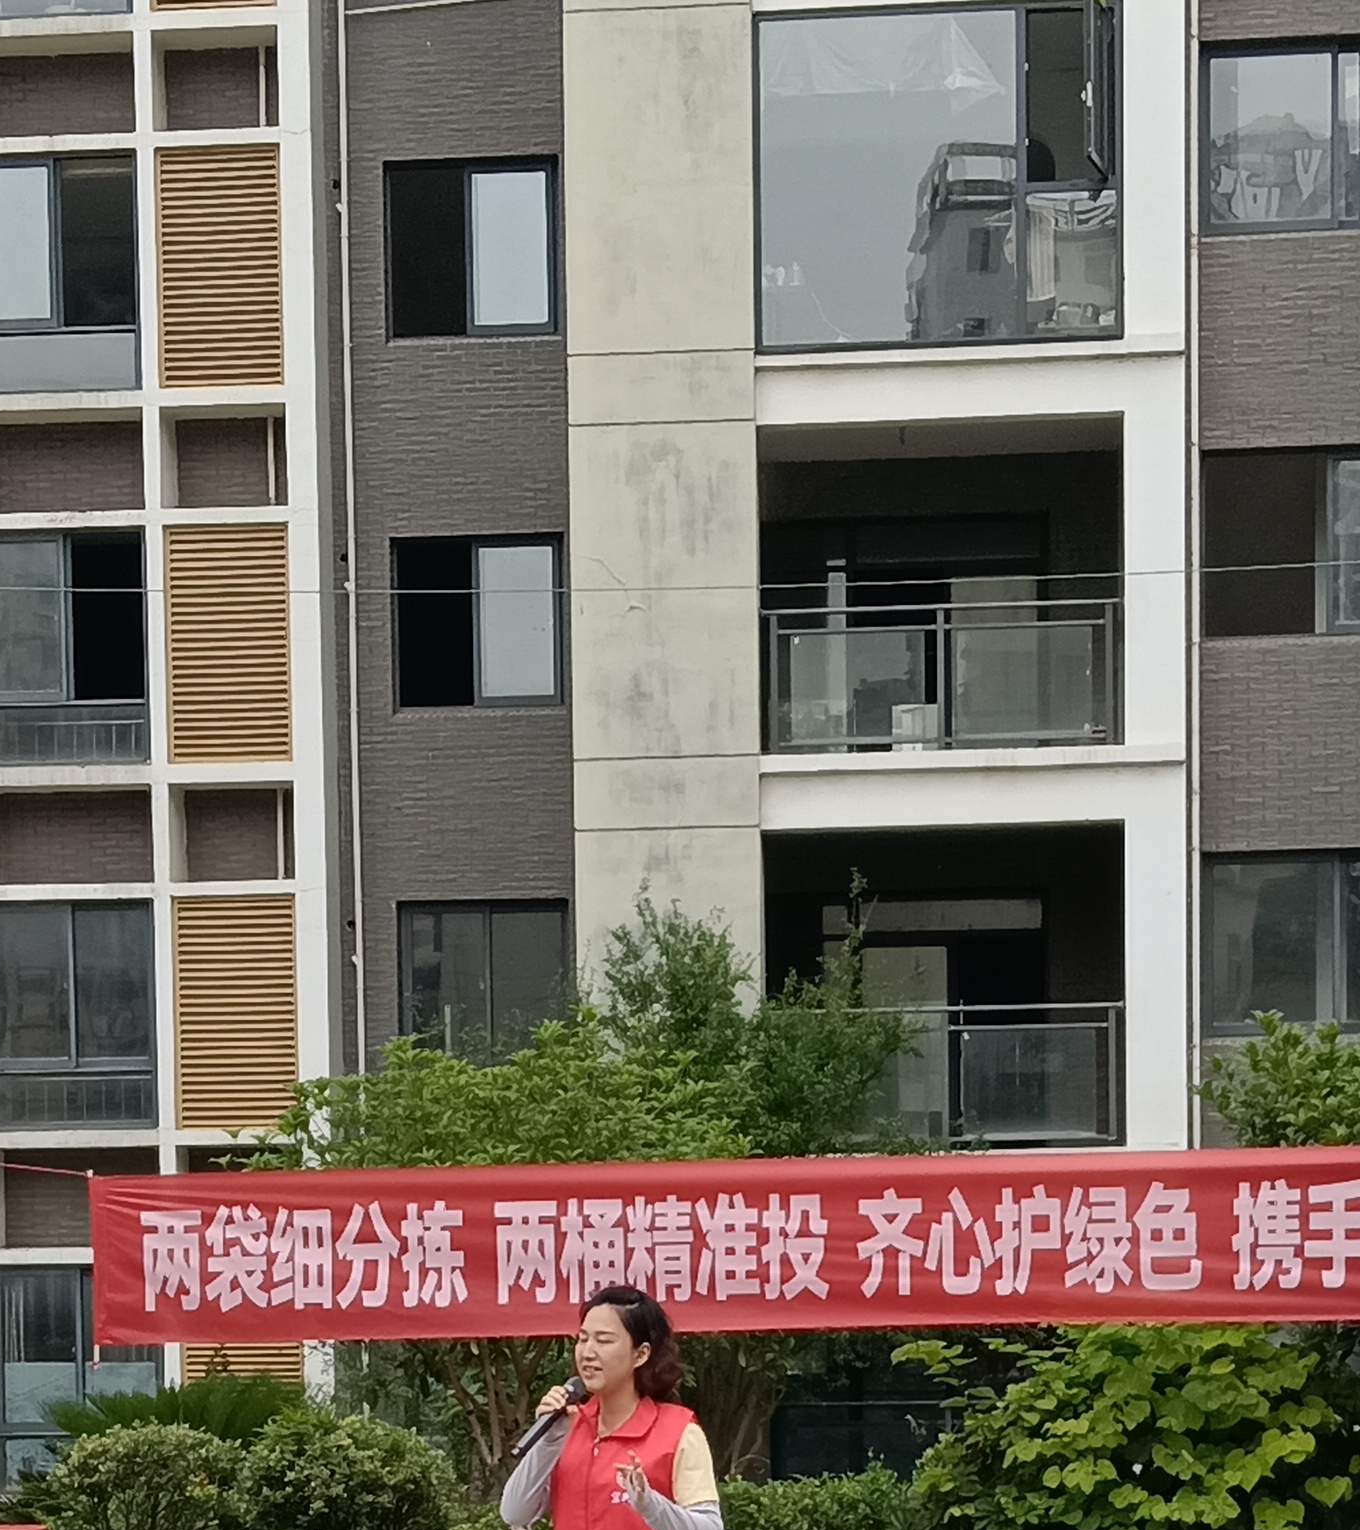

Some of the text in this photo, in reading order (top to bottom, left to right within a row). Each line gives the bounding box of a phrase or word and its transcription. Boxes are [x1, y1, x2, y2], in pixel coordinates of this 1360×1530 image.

[139, 1201, 468, 1313] 两袋细分拣
[494, 1193, 828, 1307] 两桶精准投
[857, 1182, 1203, 1298] 齐心护绿色
